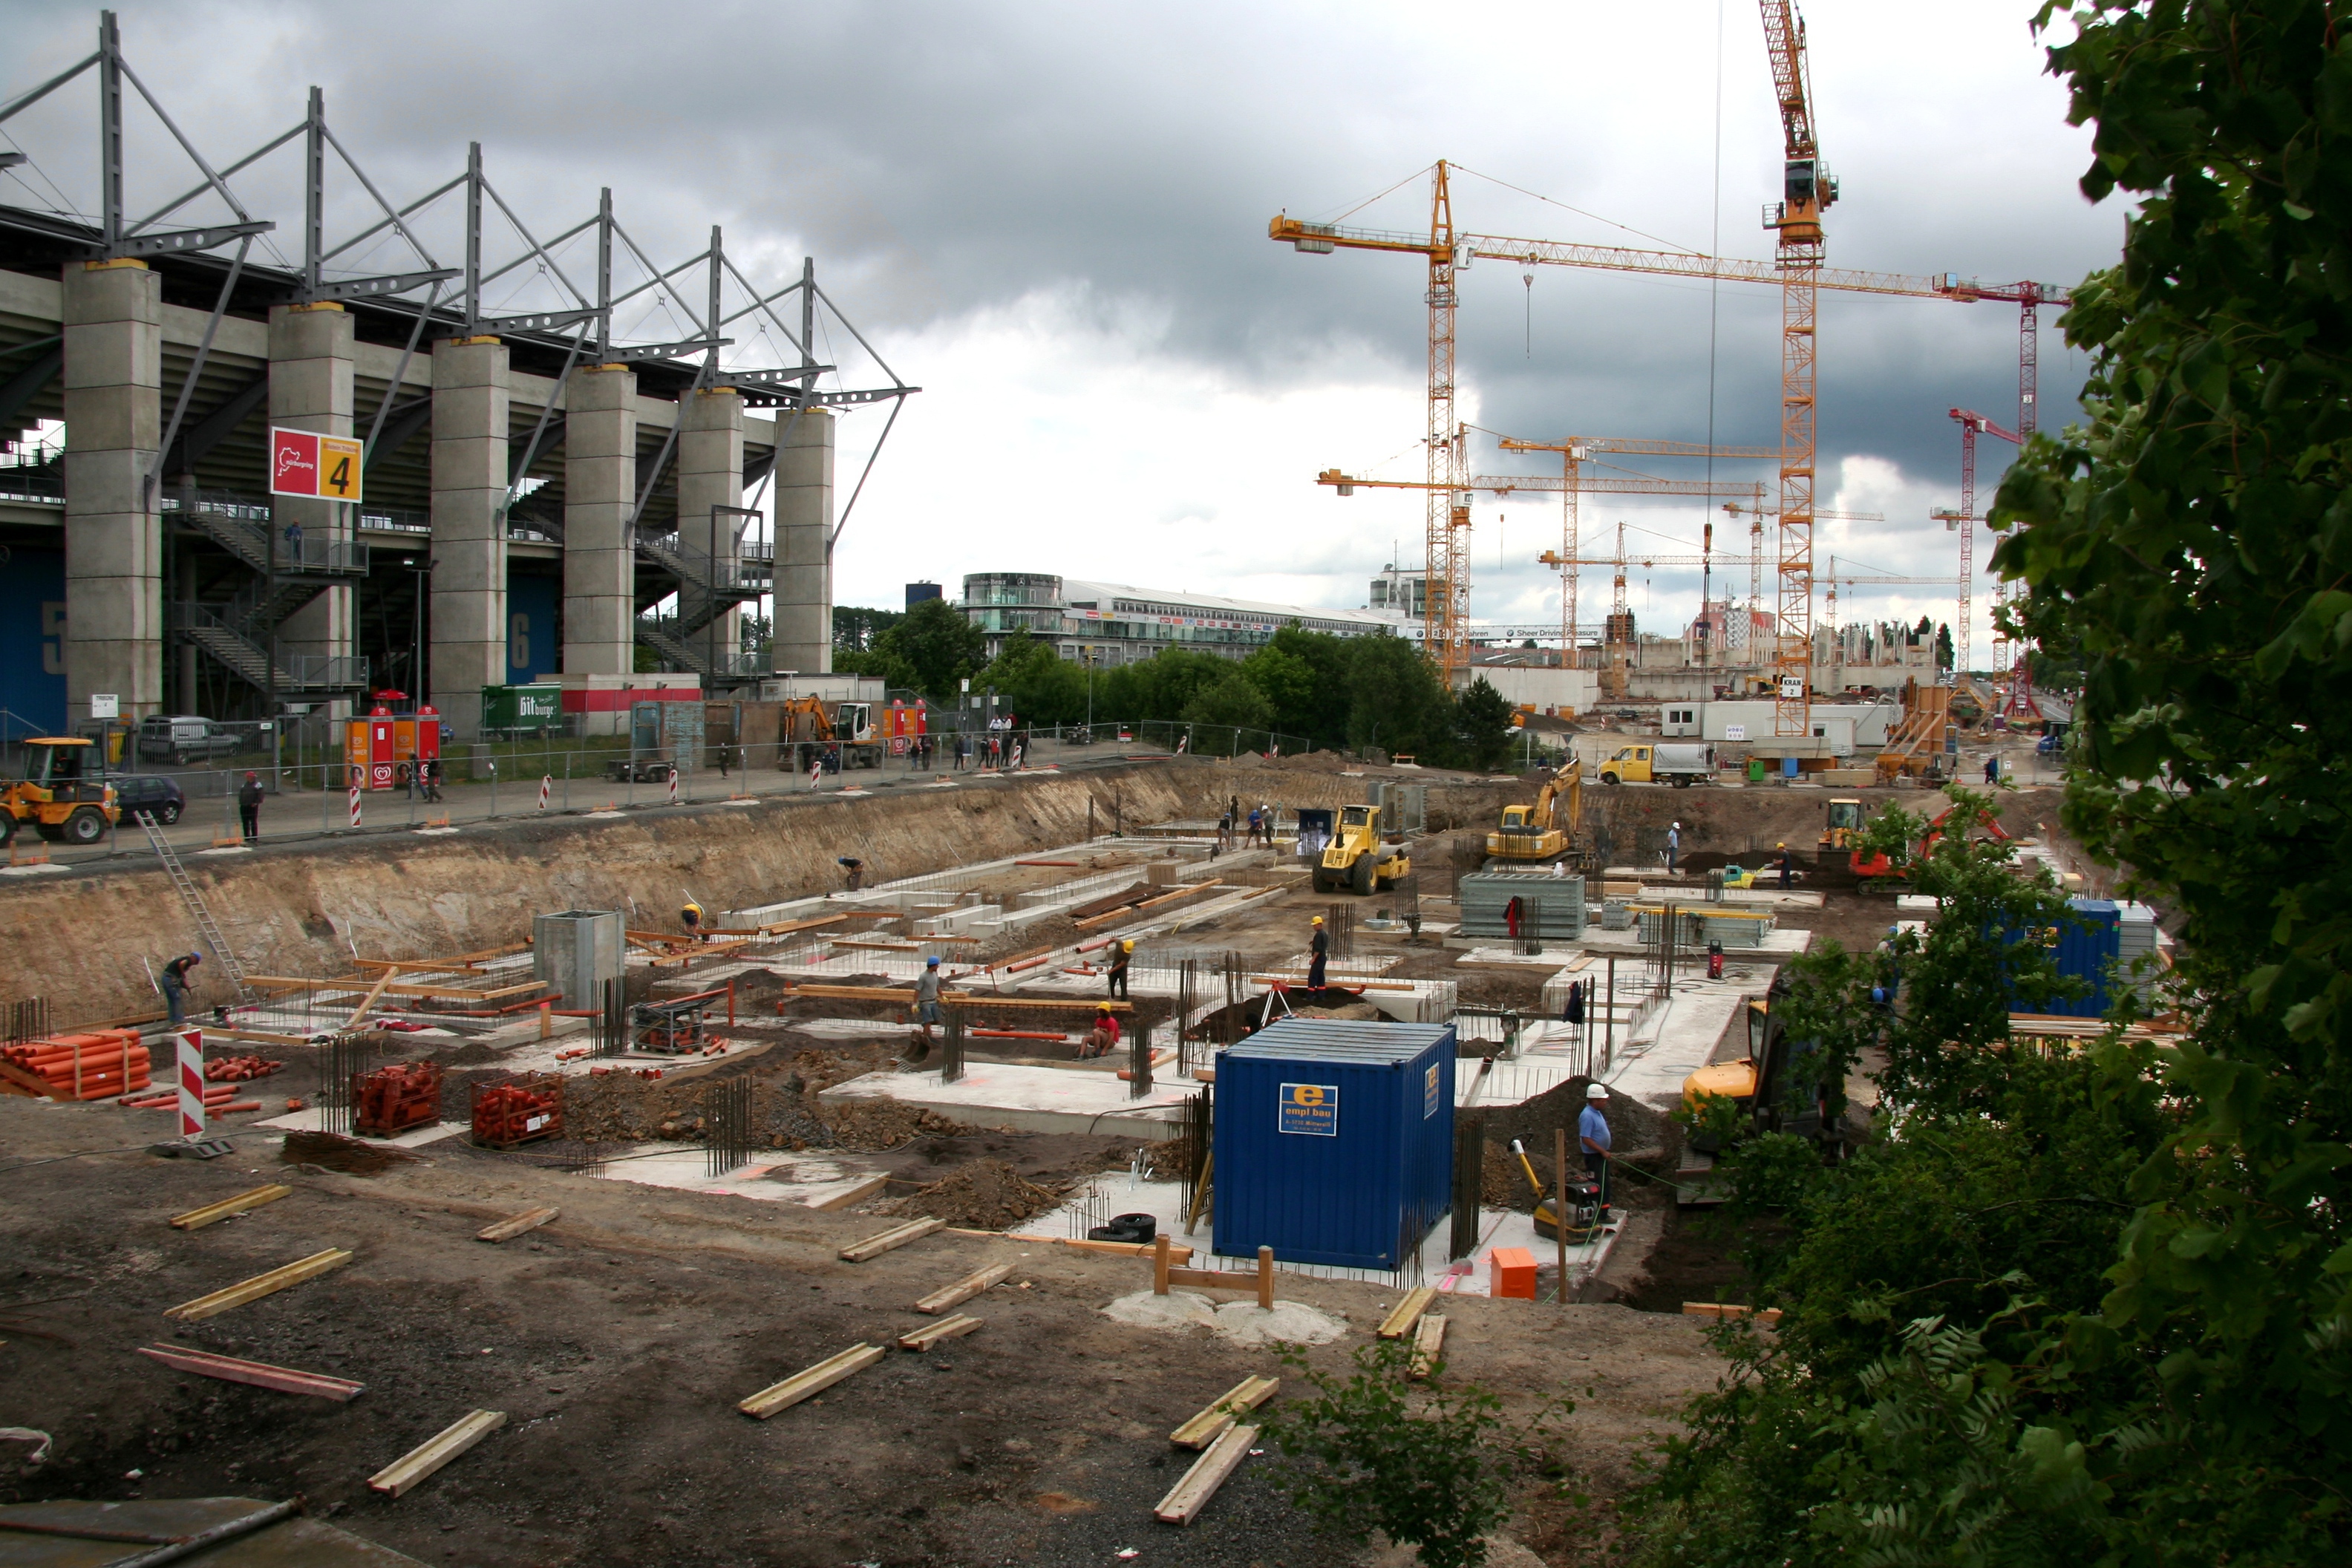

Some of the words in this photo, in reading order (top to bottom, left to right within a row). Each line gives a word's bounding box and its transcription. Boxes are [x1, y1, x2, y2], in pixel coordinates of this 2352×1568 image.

[2025, 395, 2031, 403] 3
[330, 457, 351, 494] 4
[42, 601, 68, 674] 5
[512, 612, 529, 668] 6
[1293, 1085, 1324, 1107] e
[1286, 1108, 1310, 1117] empl
[1313, 1108, 1331, 1117] bau
